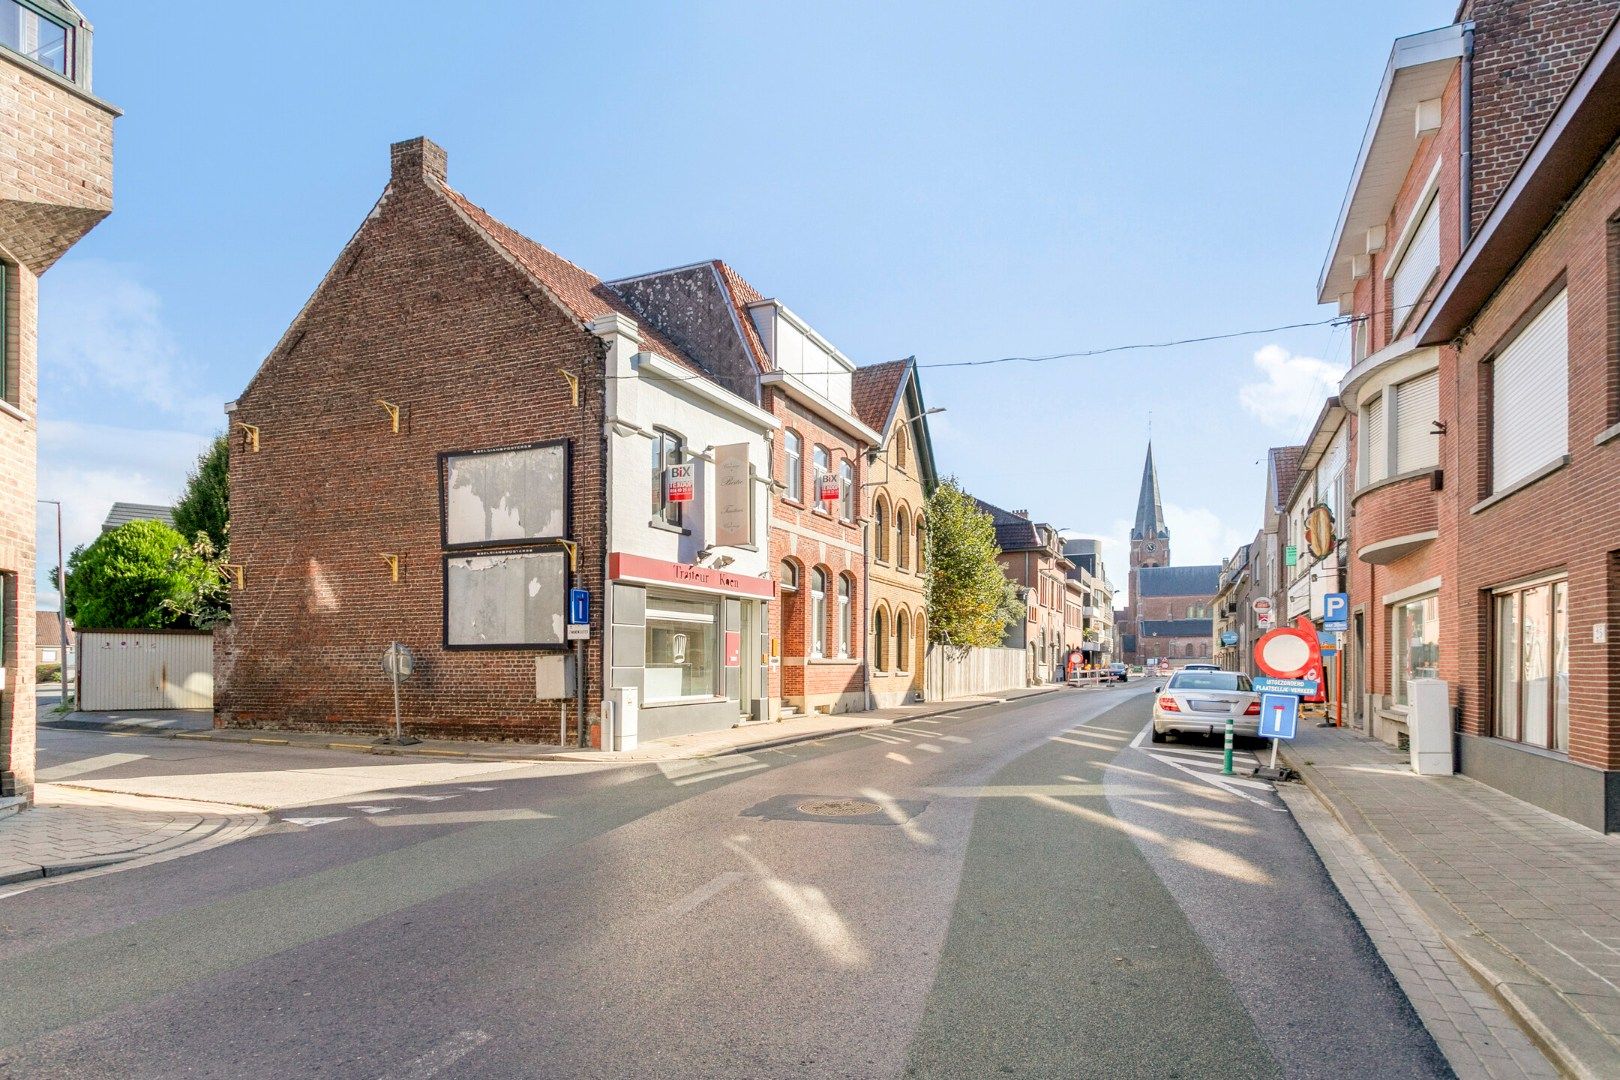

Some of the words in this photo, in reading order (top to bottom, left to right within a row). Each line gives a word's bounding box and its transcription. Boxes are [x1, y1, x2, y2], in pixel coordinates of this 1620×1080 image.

[673, 565, 709, 583] Traiteur
[719, 573, 739, 588] Koen
[1327, 597, 1345, 618] P
[1266, 679, 1305, 687] UITGEZONDERD
